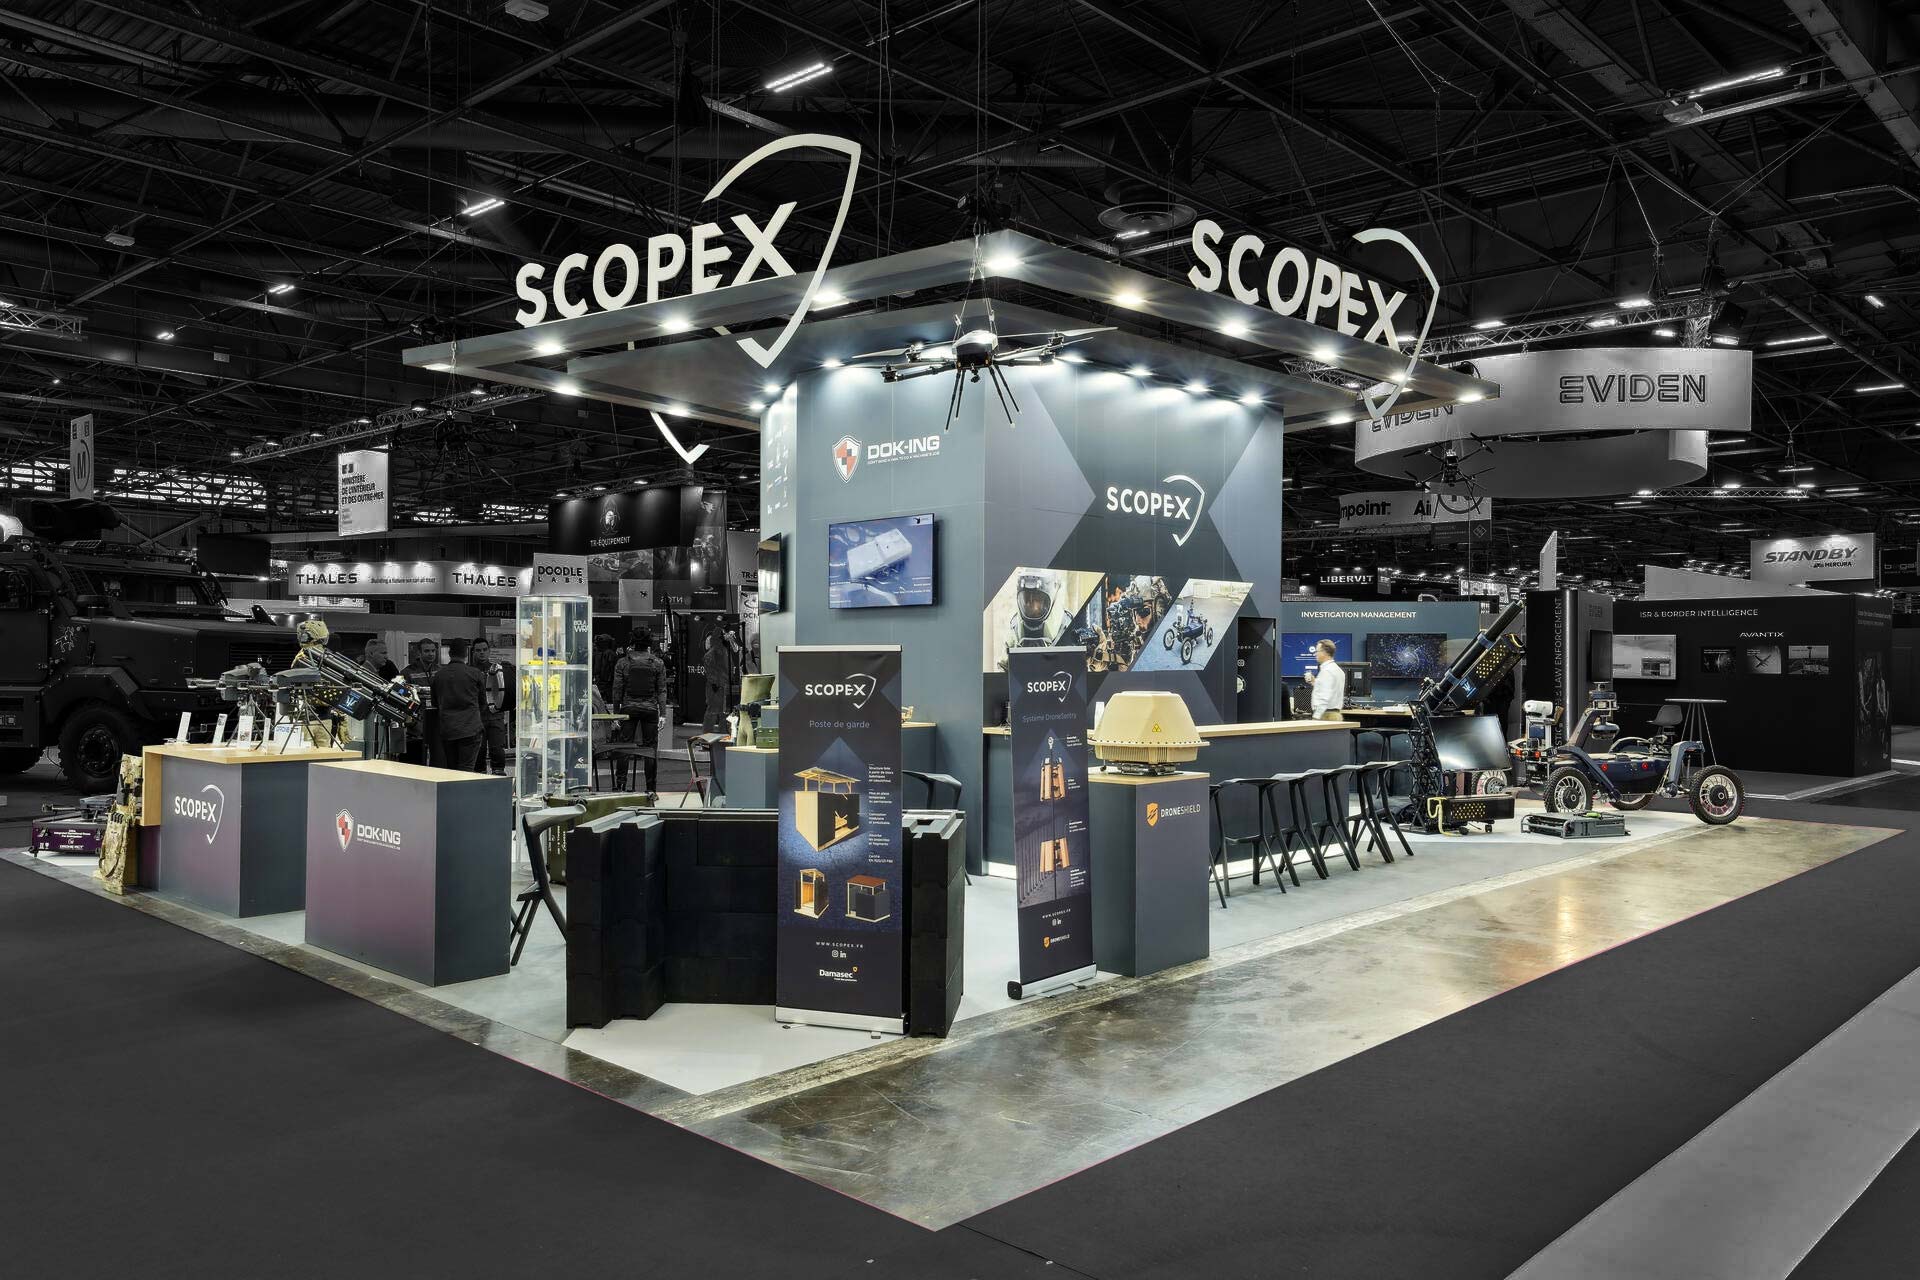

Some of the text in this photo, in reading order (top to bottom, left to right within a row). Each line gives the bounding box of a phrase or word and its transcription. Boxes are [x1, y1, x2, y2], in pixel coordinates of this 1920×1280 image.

[515, 201, 797, 328] SCOPEX
[1187, 219, 1407, 352] SCOPEX
[1559, 374, 1706, 404] EVIDEN
[867, 435, 940, 460] DOK-ING
[1106, 486, 1191, 520] SCOPEX
[1763, 547, 1858, 563] STANDBY
[296, 573, 358, 585] THALES
[538, 565, 583, 577] DOODLE
[452, 572, 517, 588] THALES
[1301, 611, 1417, 619] INVESTIGATION MANAGEMENT
[1661, 610, 1696, 618] BORDER
[1697, 608, 1759, 617] INTELLIGENCE
[1554, 598, 1562, 665] ENFORCEMENT
[1027, 680, 1067, 693] SCOPEX
[1554, 669, 1562, 688] LAW
[805, 684, 867, 696] SCOPEX
[809, 720, 870, 730] Poste de garde
[174, 796, 217, 823] SCOPEX
[1160, 803, 1201, 818] DRONESHIELD
[357, 823, 401, 844] DOK-ING
[819, 969, 853, 979] Damasec
